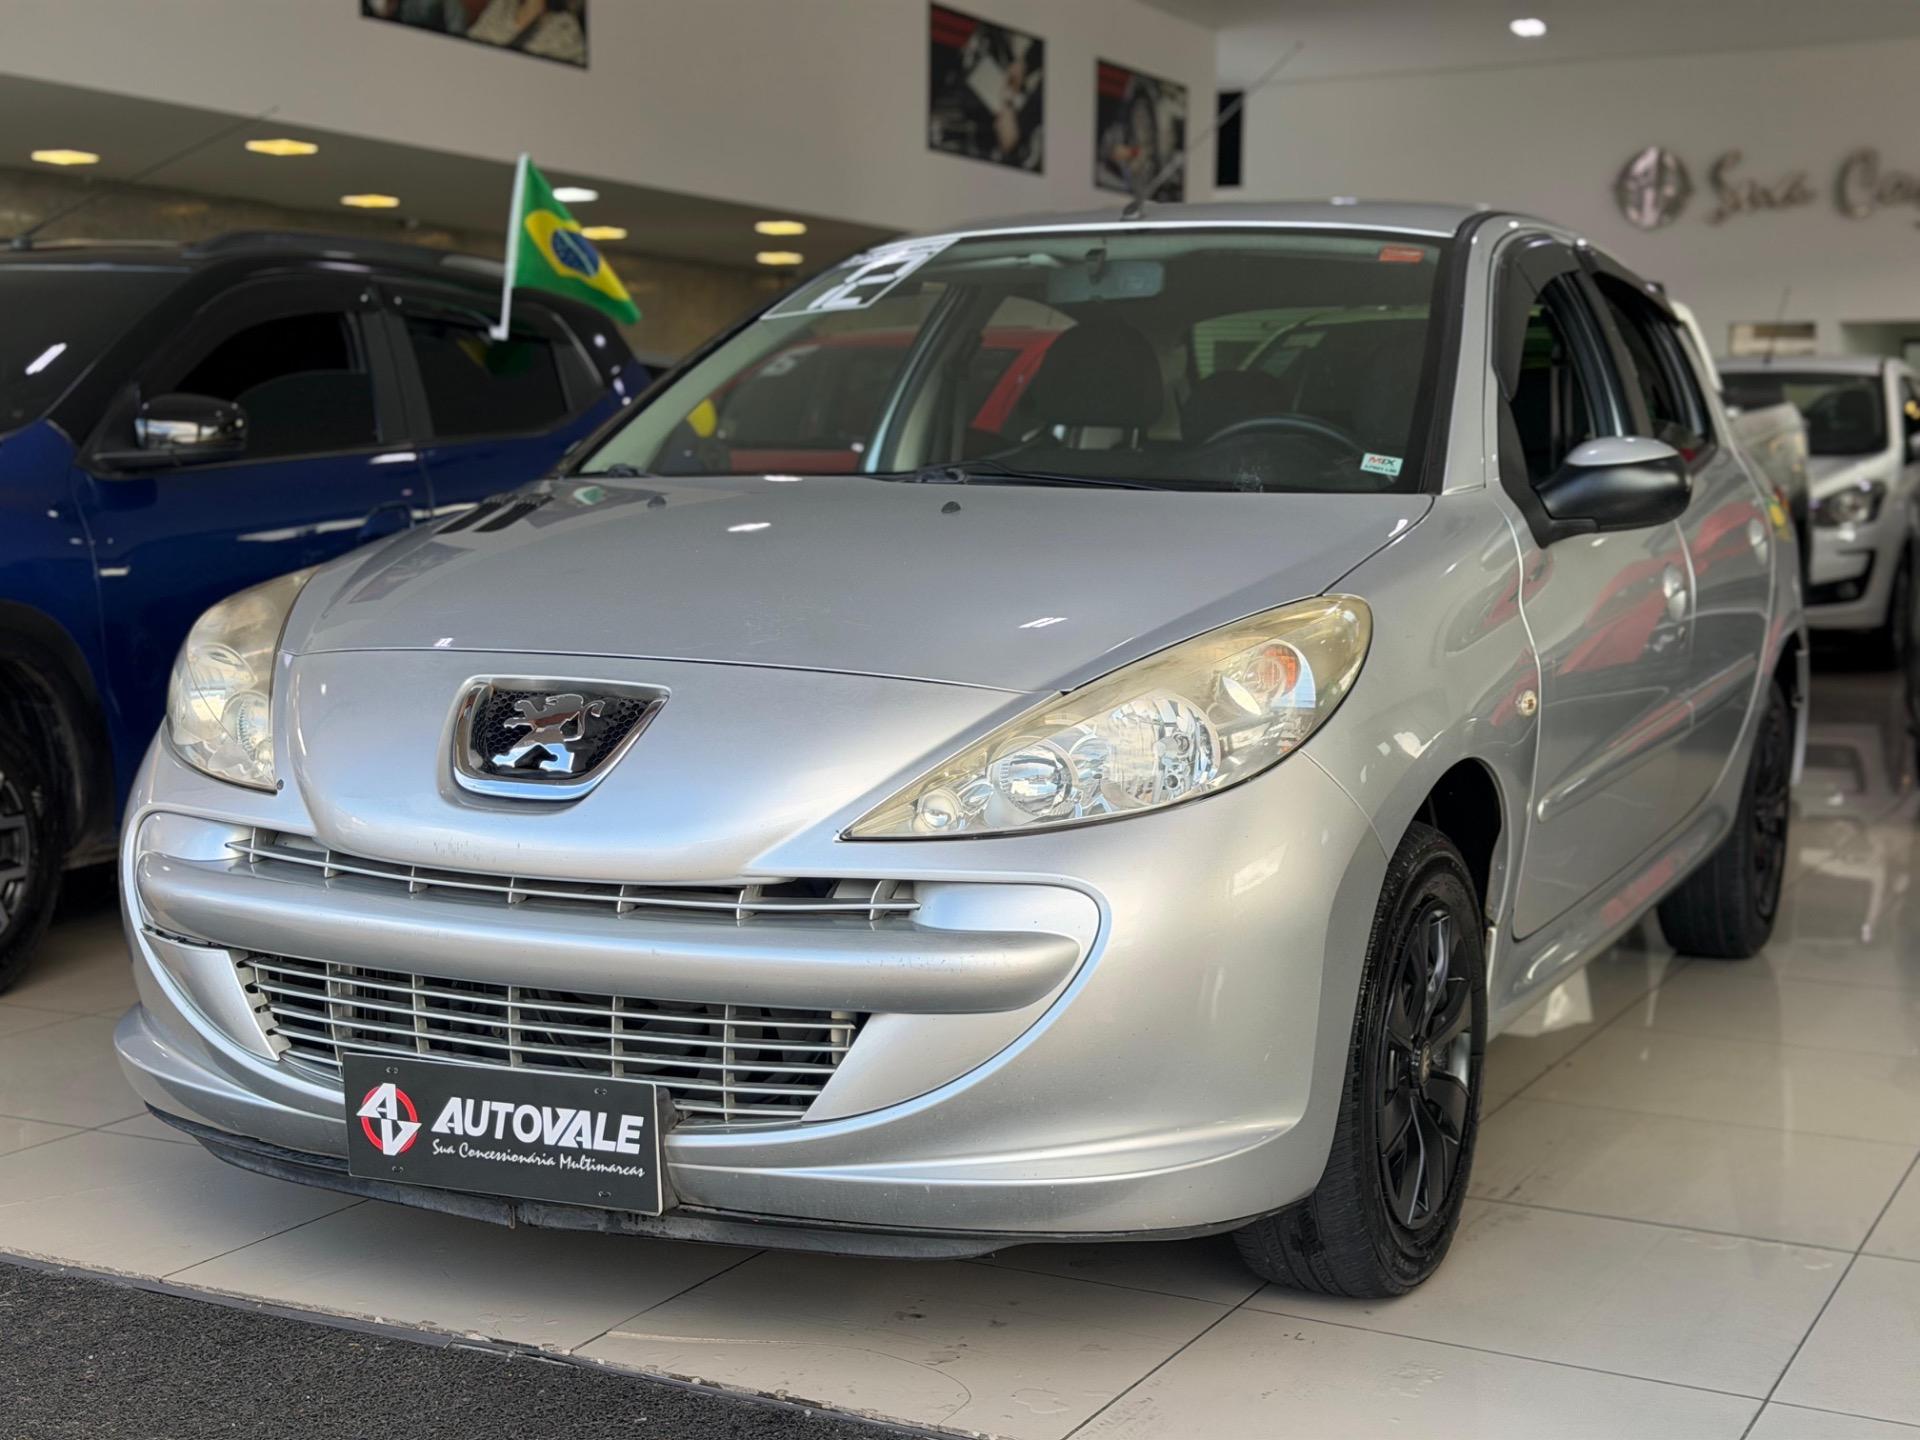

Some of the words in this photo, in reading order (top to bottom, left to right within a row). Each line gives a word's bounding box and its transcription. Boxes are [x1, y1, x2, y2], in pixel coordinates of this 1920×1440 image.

[1705, 148, 1816, 227] Sua
[431, 1097, 644, 1154] AUTOVALE
[432, 1138, 456, 1155] Sua
[458, 1142, 556, 1167] Concessionária
[559, 1153, 646, 1178] Multimarcas
